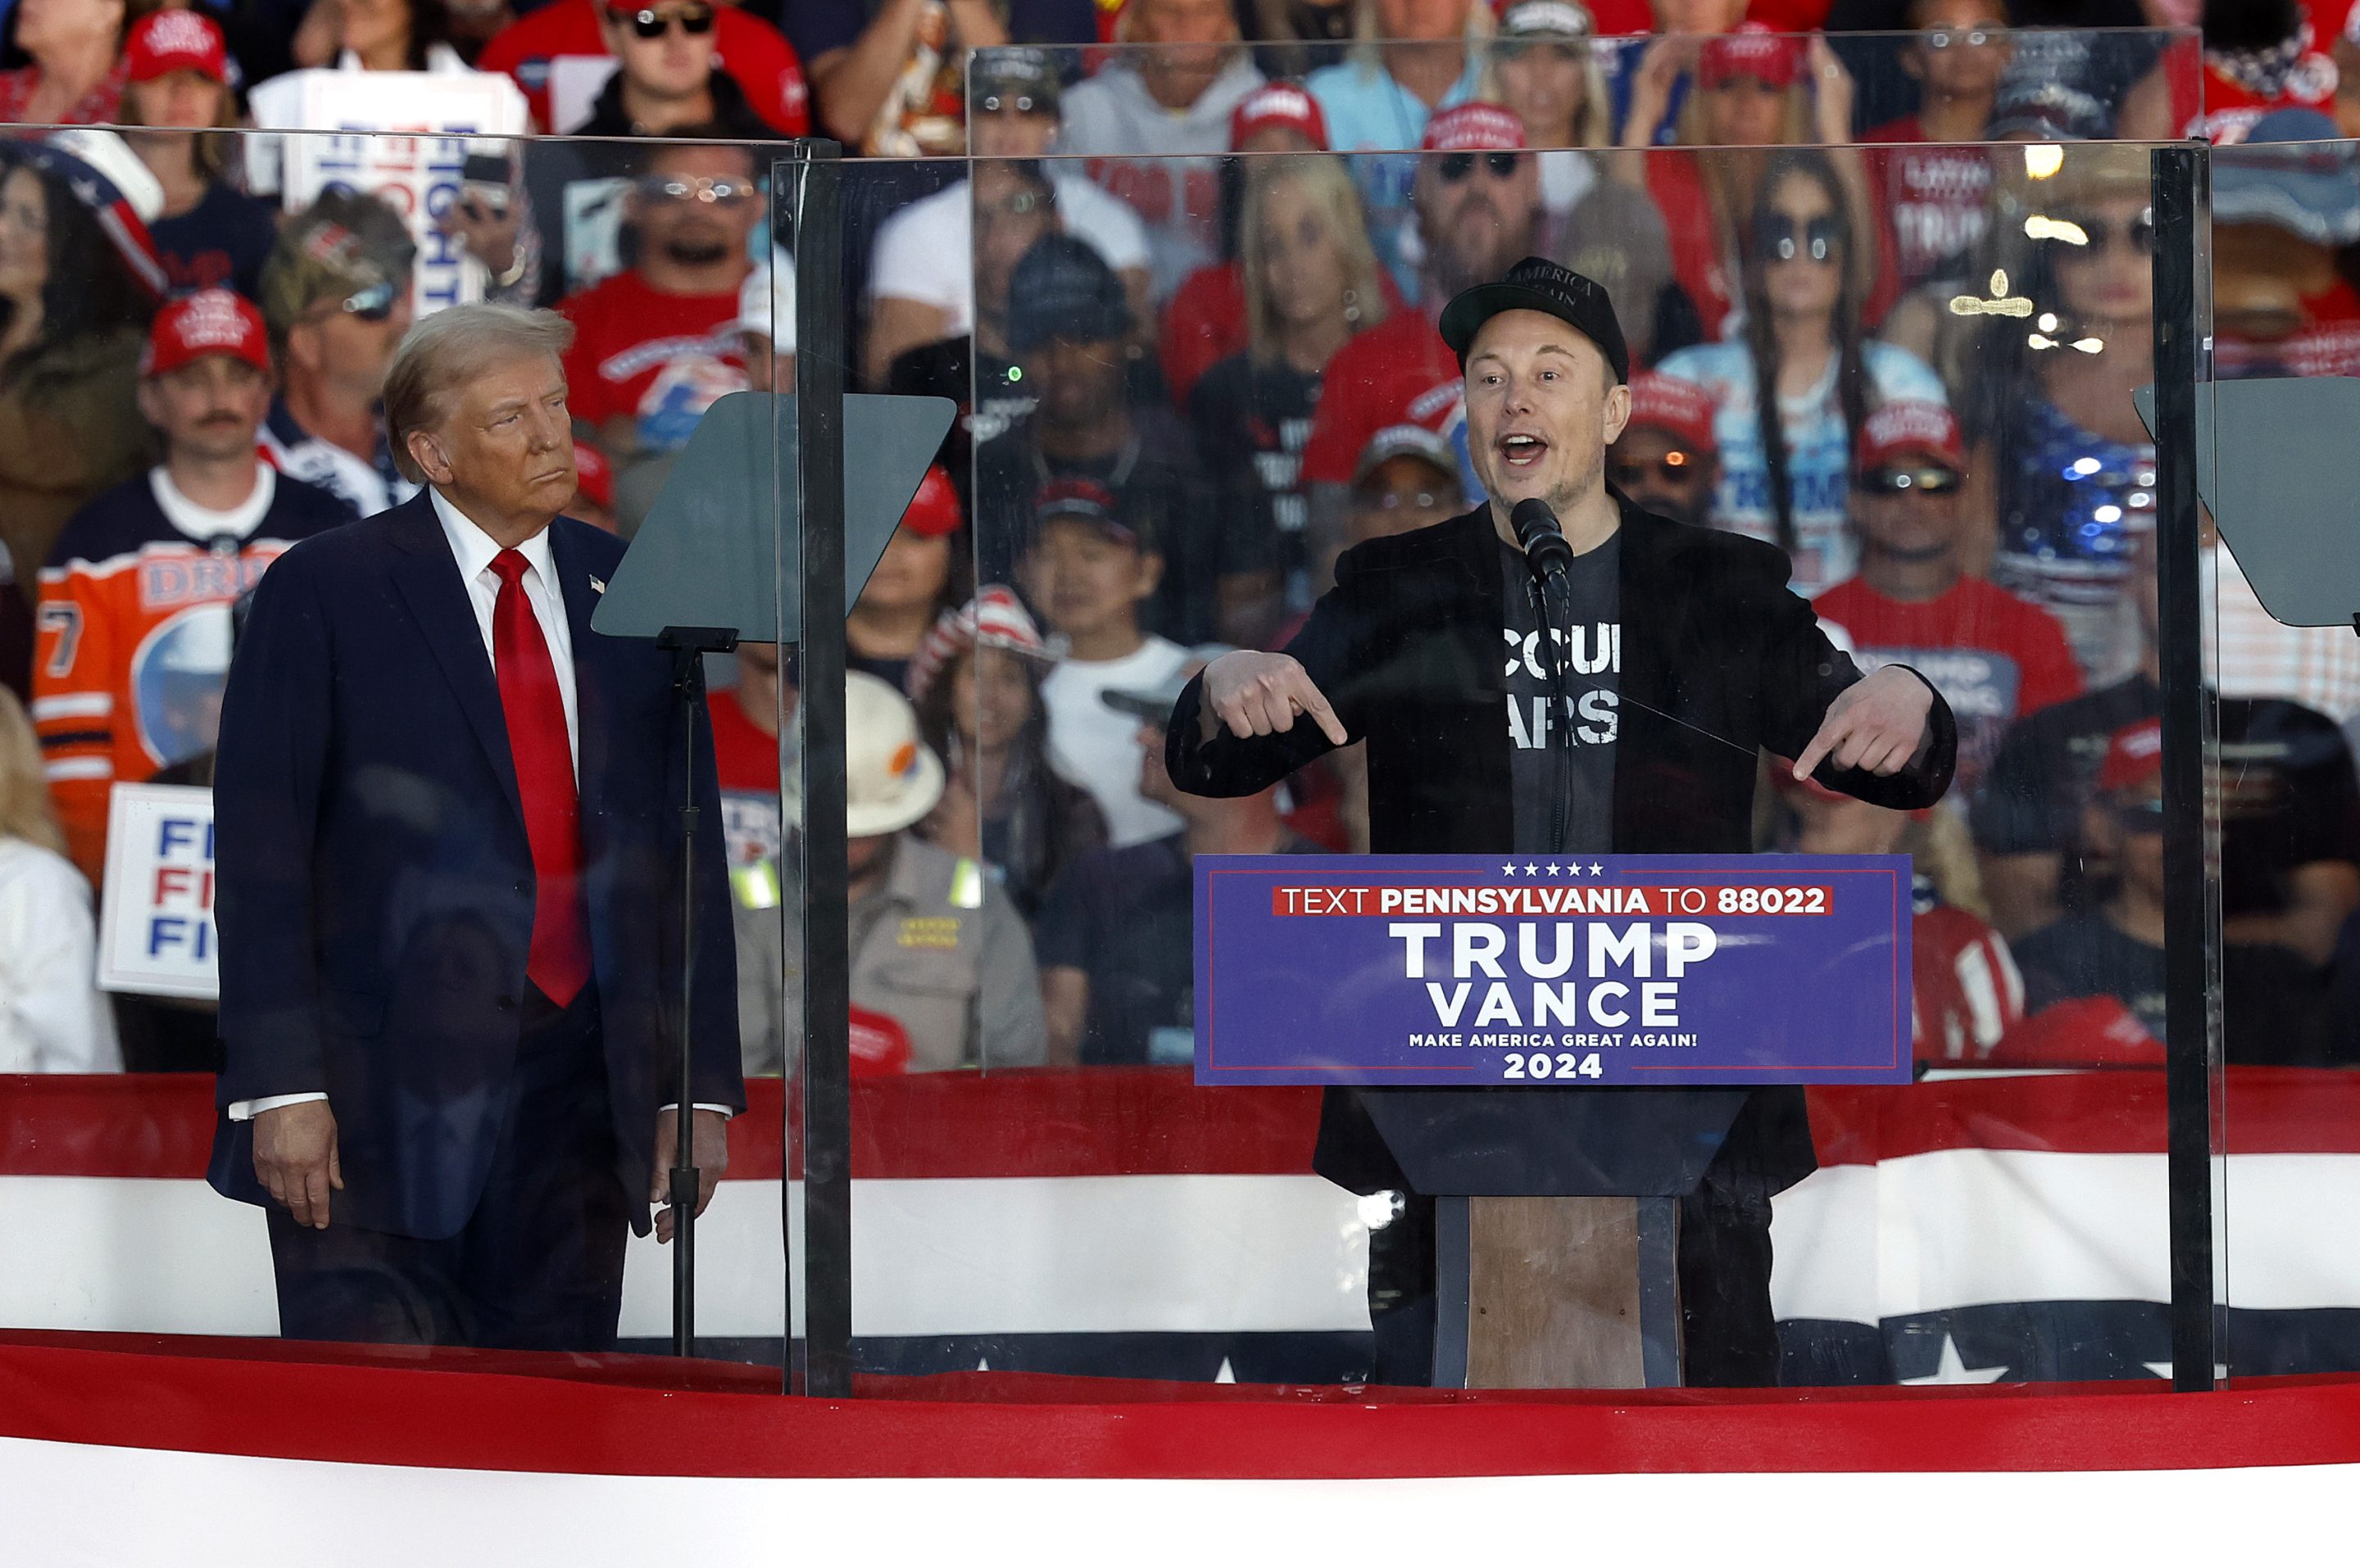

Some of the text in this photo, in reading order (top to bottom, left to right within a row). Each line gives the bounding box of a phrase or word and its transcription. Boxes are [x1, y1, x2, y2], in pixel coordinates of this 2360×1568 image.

[425, 125, 477, 306] FIGHT
[1516, 265, 1594, 297] AMERICA
[1281, 887, 1825, 913] TEXT PENNSYLVANIA TO 88022
[1389, 922, 1718, 979] TRUMP
[1425, 981, 1679, 1028] VANCE
[1409, 1034, 1698, 1047] MAKE AMERICA GREAT AGAIN!
[1504, 1053, 1603, 1079] 2024
